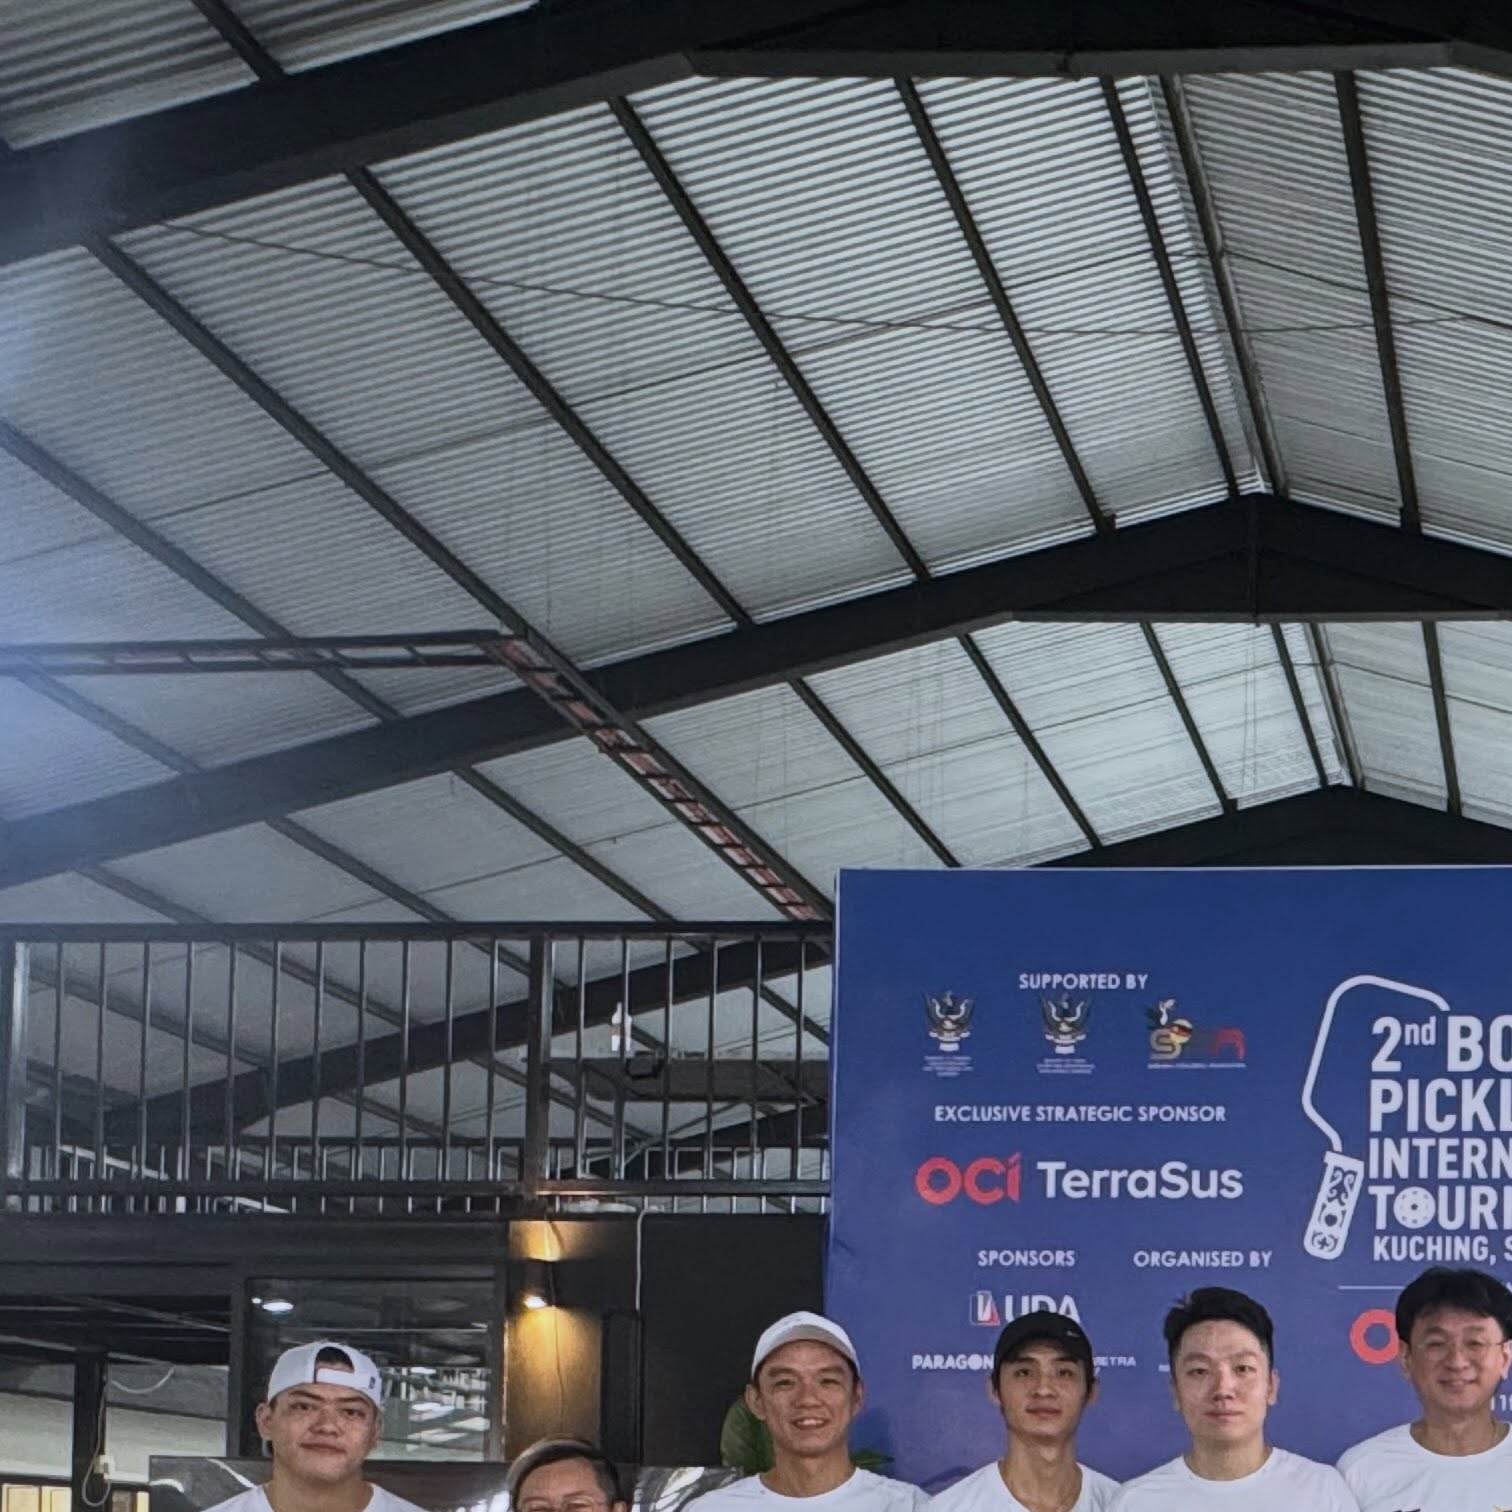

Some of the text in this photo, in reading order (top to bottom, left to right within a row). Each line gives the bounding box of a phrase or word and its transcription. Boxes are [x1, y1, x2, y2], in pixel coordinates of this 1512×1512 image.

[1019, 972, 1149, 990] SUPPORTED BY
[1370, 1015, 1437, 1073] 2nd
[934, 1105, 1226, 1122] EXCLUSIVE STRATEGIC SPONSOR
[1036, 1160, 1244, 1199] TerraSus
[977, 1250, 1076, 1267] SPONSORS
[1133, 1250, 1273, 1268] ORGANISED BY
[1373, 1236, 1497, 1266] KUCHING,
